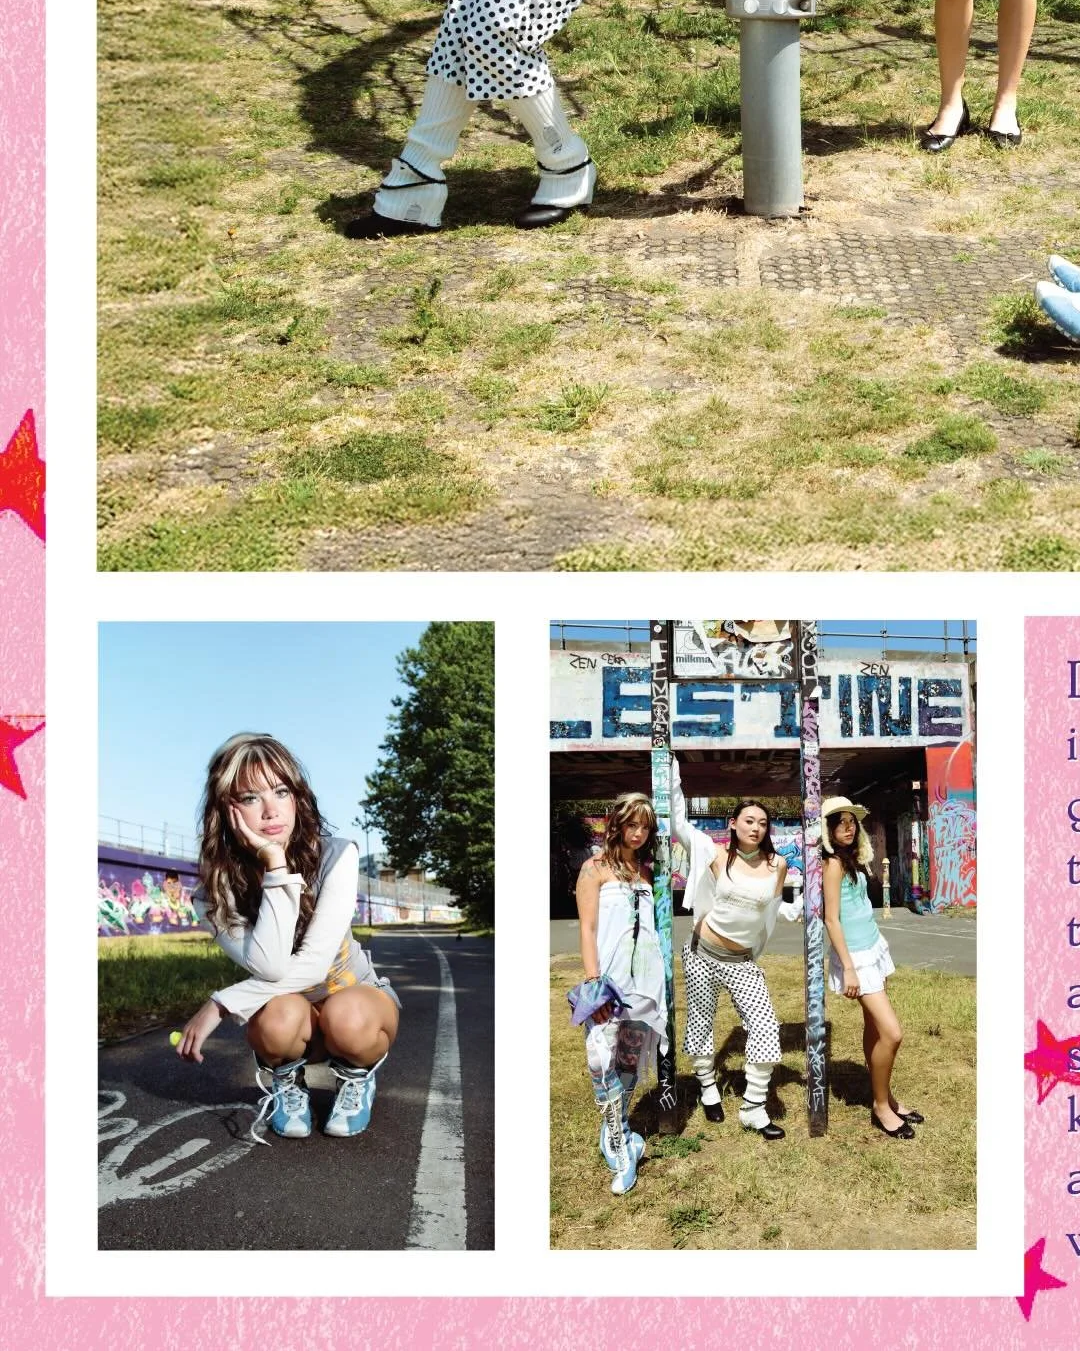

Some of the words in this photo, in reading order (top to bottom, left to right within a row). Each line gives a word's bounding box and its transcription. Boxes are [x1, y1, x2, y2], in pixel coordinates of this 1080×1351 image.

[569, 653, 597, 670] ZEN
[675, 654, 711, 664] milkma
[859, 661, 890, 676] ZEN
